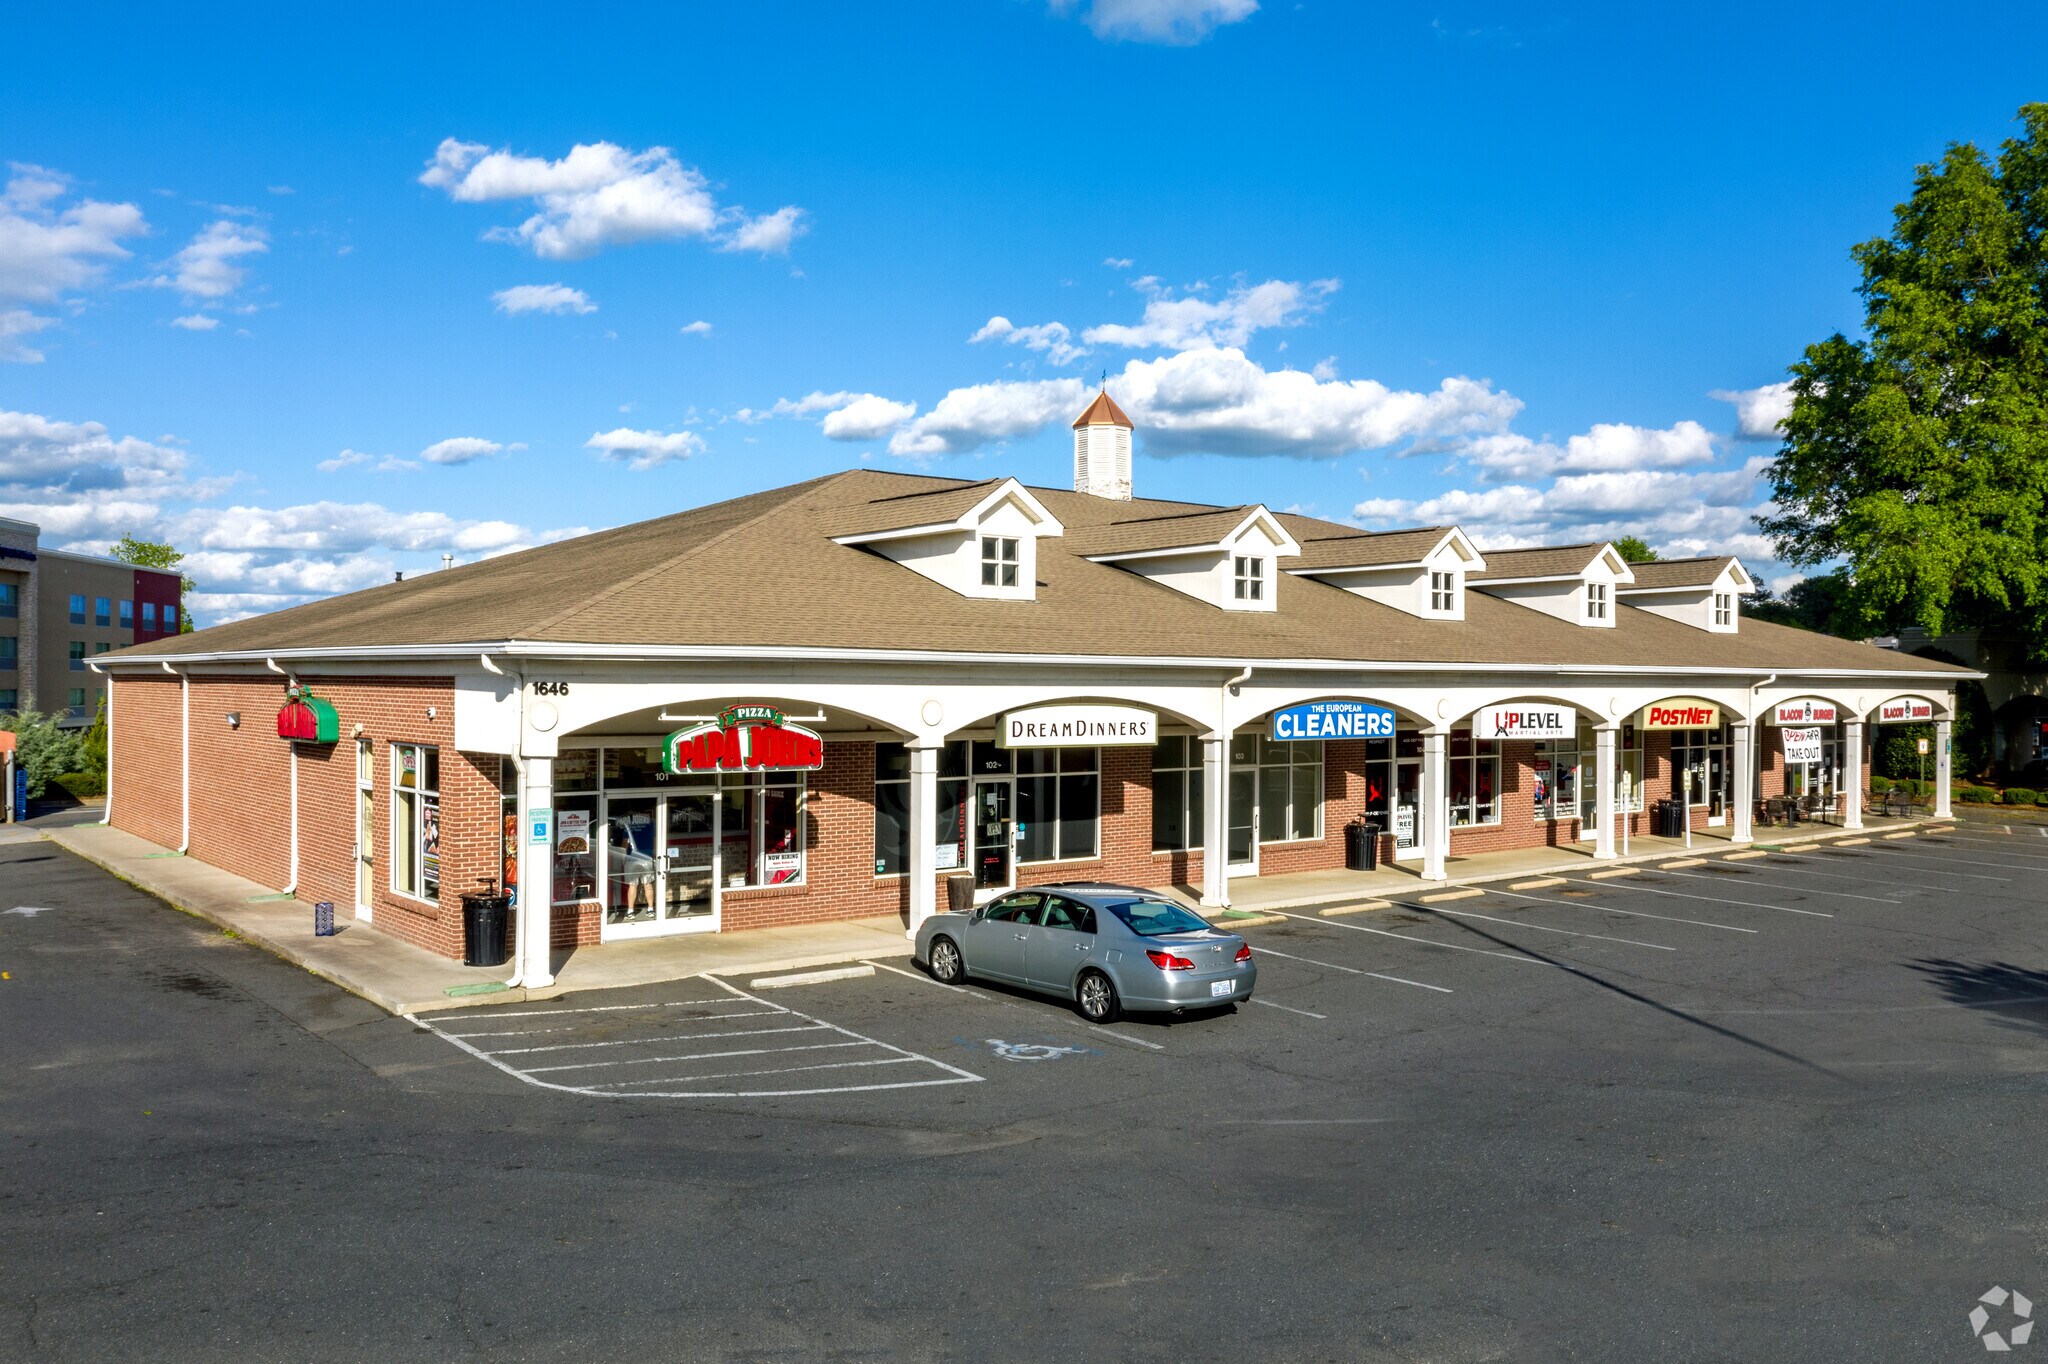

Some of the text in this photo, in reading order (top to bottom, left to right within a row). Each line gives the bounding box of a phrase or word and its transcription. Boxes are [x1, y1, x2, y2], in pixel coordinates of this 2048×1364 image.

[533, 682, 569, 696] 1646
[737, 708, 772, 718] PIZZA
[1311, 704, 1362, 713] THE EUROPEAN
[1779, 708, 1804, 721] BLACOW
[1812, 708, 1835, 720] BURGER
[1883, 706, 1930, 719] BLACOW BURGER
[1276, 712, 1393, 738] CLEANERS
[1494, 710, 1563, 732] UPLEVEL
[1784, 729, 1805, 742] OPEN
[678, 727, 743, 768] PAPA
[1787, 747, 1820, 760] TAKE OUT
[655, 772, 669, 781] 101
[988, 823, 1001, 835] OPEN
